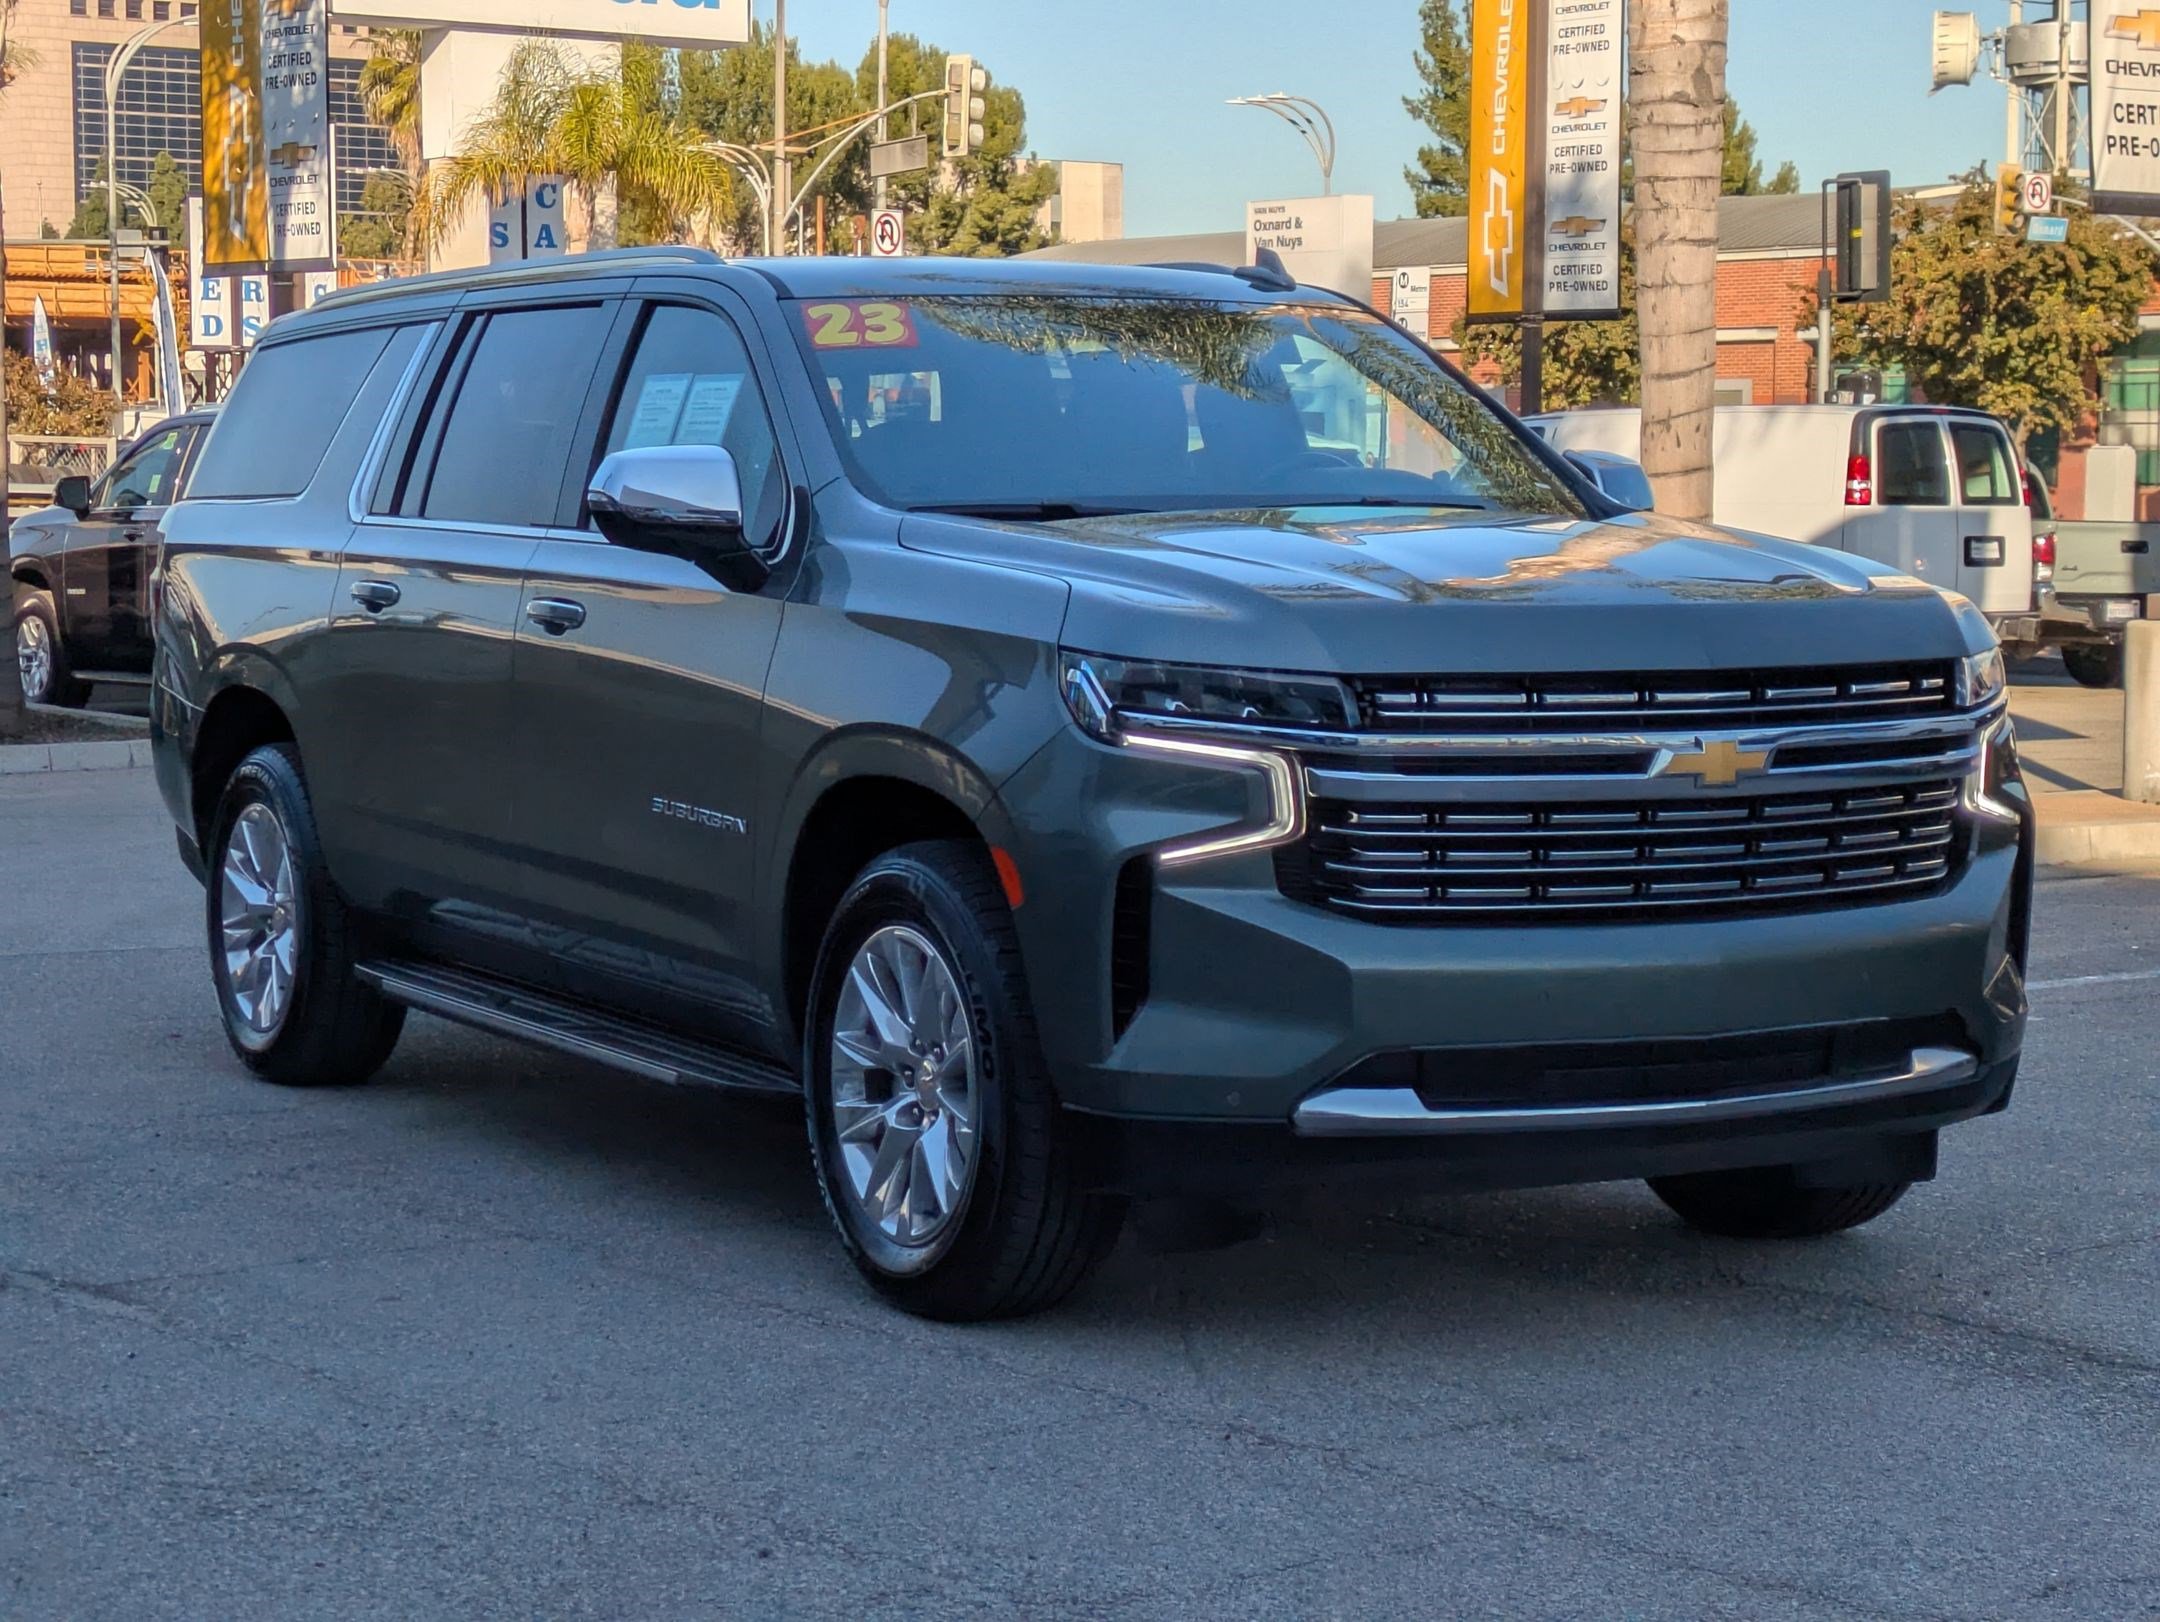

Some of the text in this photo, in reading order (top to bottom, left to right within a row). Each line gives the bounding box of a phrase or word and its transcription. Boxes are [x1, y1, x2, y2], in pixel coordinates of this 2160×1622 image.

[1555, 2, 1610, 15] CHEVROLET
[265, 24, 315, 40] CHEVROLET
[1558, 23, 1605, 39] CERTIFIED
[1553, 40, 1610, 56] PRE-OWNED
[268, 51, 312, 69] CERTIFIED
[265, 72, 317, 90] PRE-OWNED
[1552, 122, 1608, 134] CHEVROLET
[1554, 144, 1603, 158] CERTIFIED
[2106, 135, 2160, 158] PRE-O
[1549, 160, 1608, 174] PRE-OWNED
[275, 201, 316, 217] CERTIFIED
[1254, 216, 1303, 232] Oxnard &
[1254, 234, 1303, 250] Van Nuys
[1549, 242, 1607, 252] CHEVROLET
[1553, 264, 1603, 276] CERTIFIED
[1548, 280, 1608, 293] PRE-OWNED
[808, 303, 906, 346] 23
[652, 797, 746, 833] SUBURBAN
